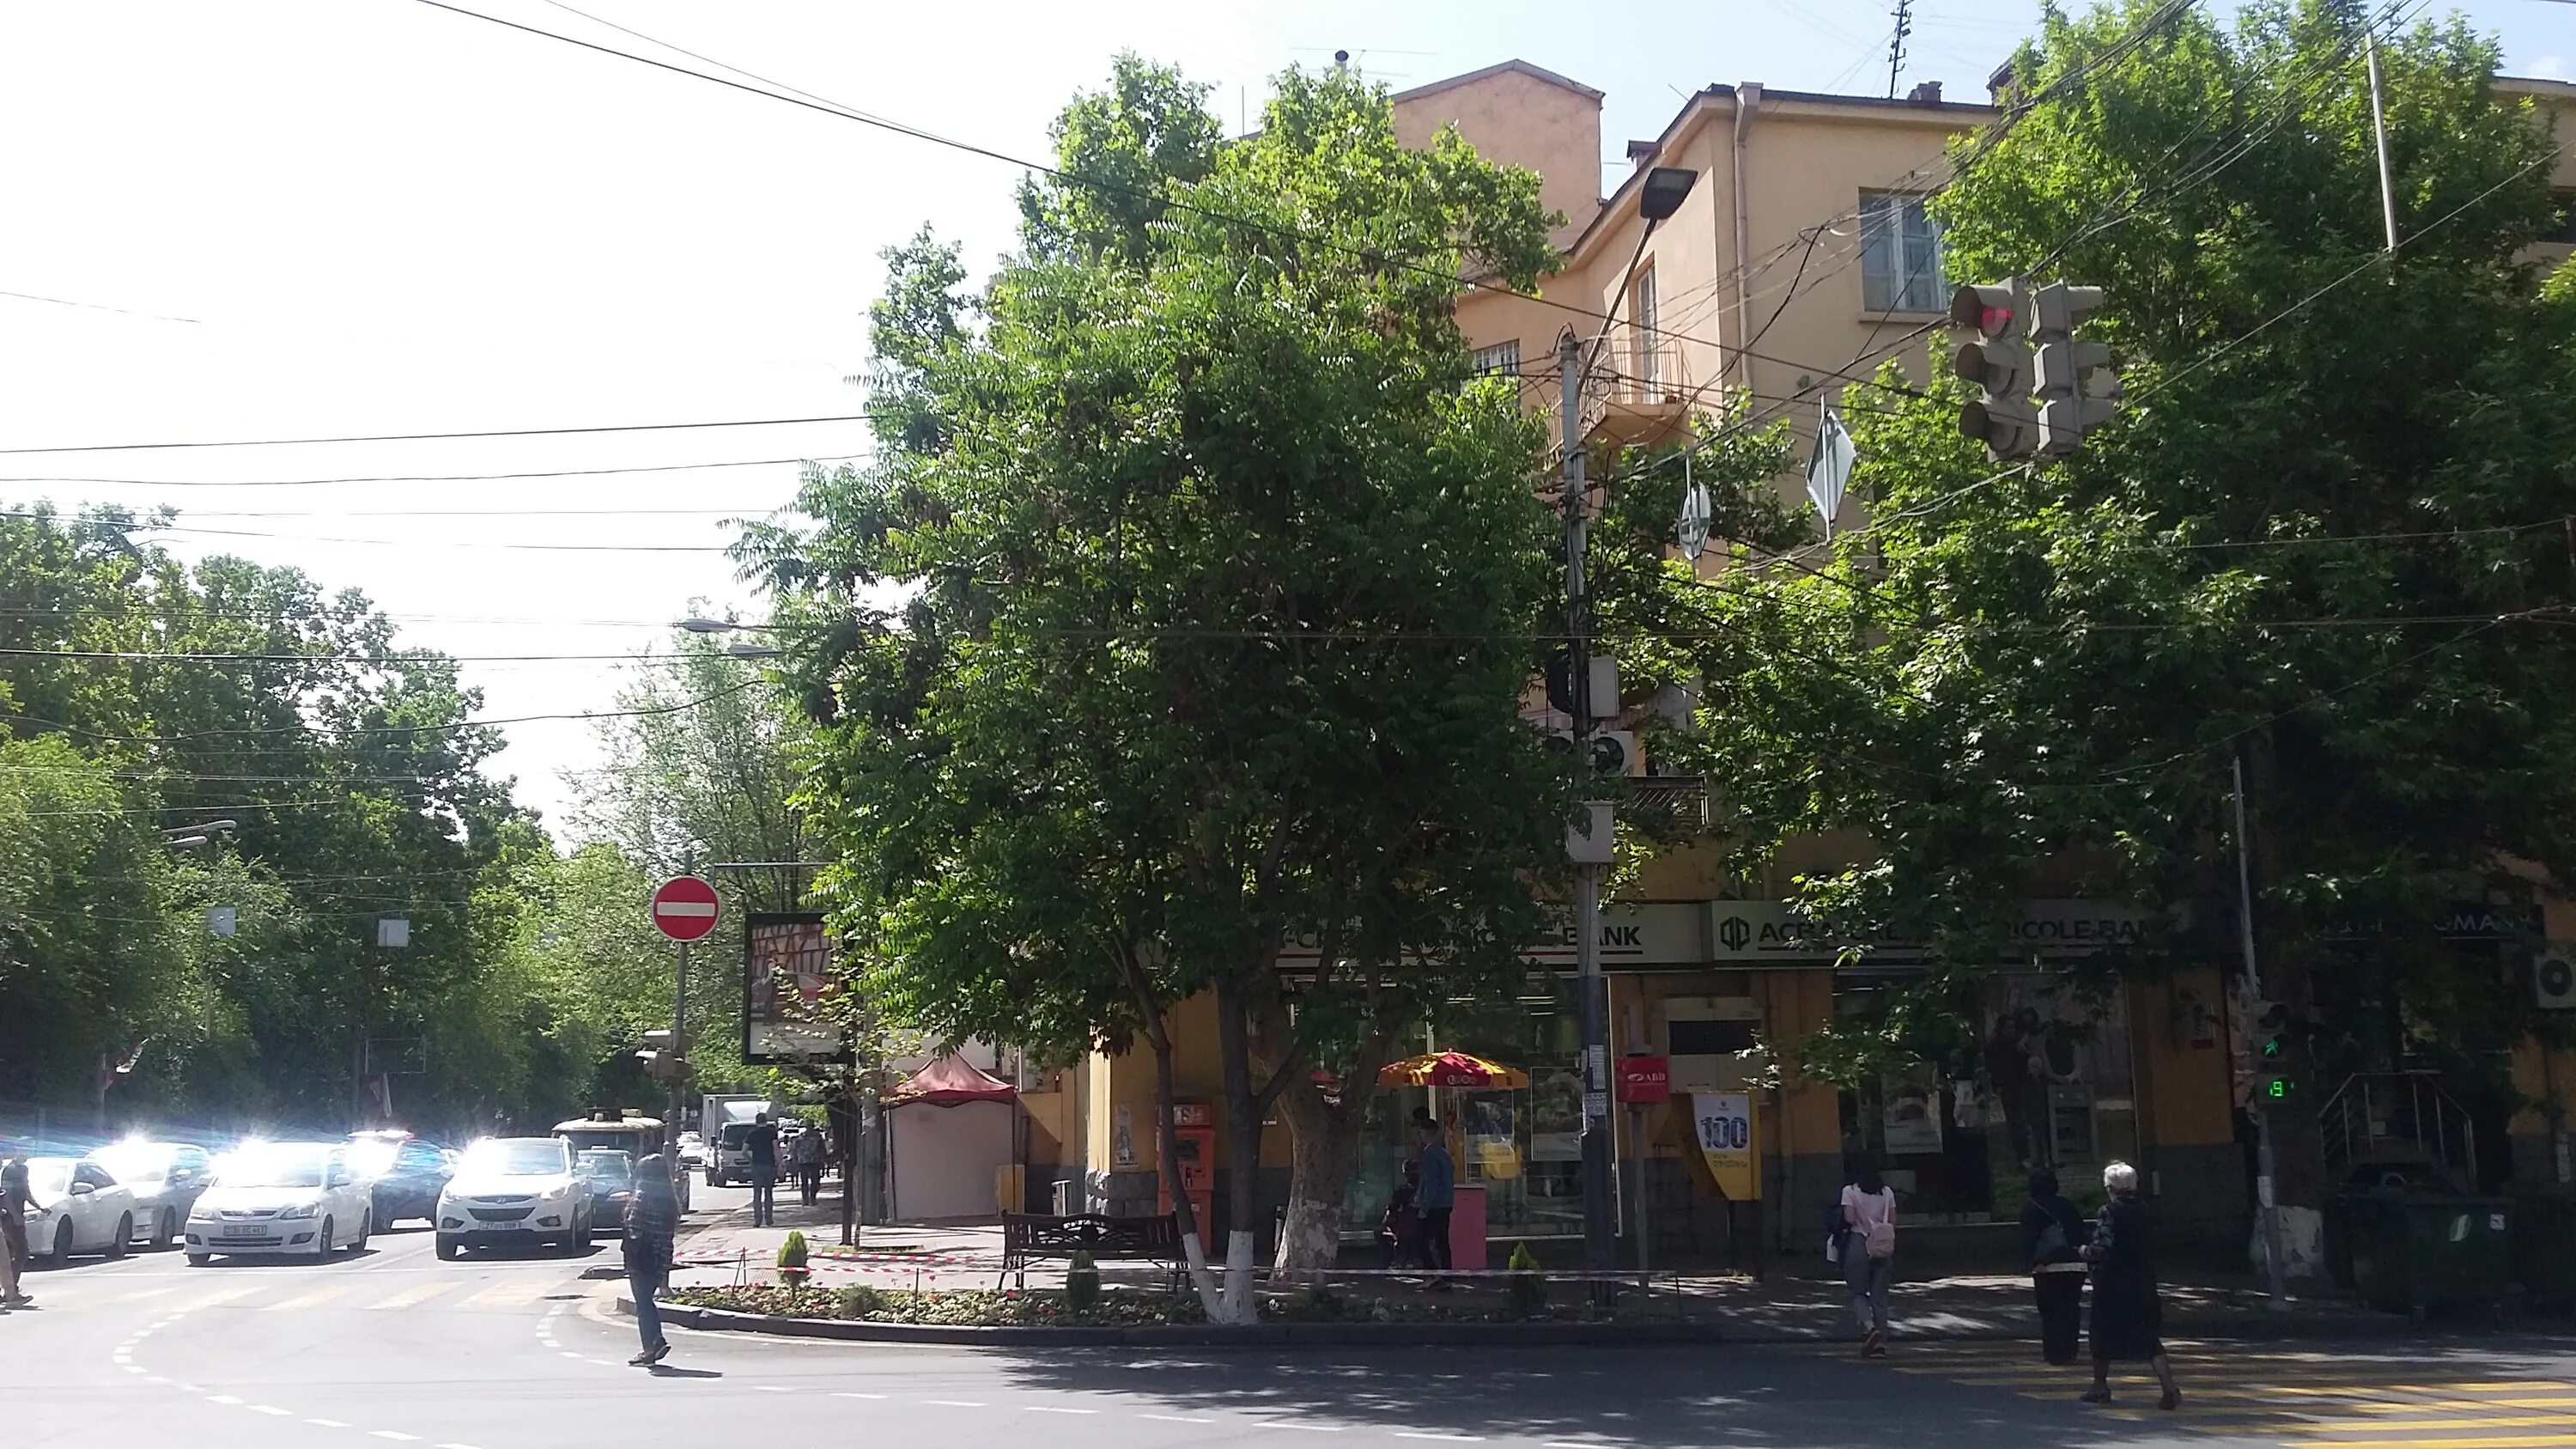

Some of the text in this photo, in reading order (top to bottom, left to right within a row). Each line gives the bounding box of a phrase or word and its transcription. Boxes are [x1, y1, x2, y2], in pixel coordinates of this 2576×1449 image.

[1563, 926, 1642, 946] BNK
[1958, 920, 2090, 941] ICOLE
[2099, 919, 2183, 941] BA
[1700, 1117, 1747, 1148] 100
